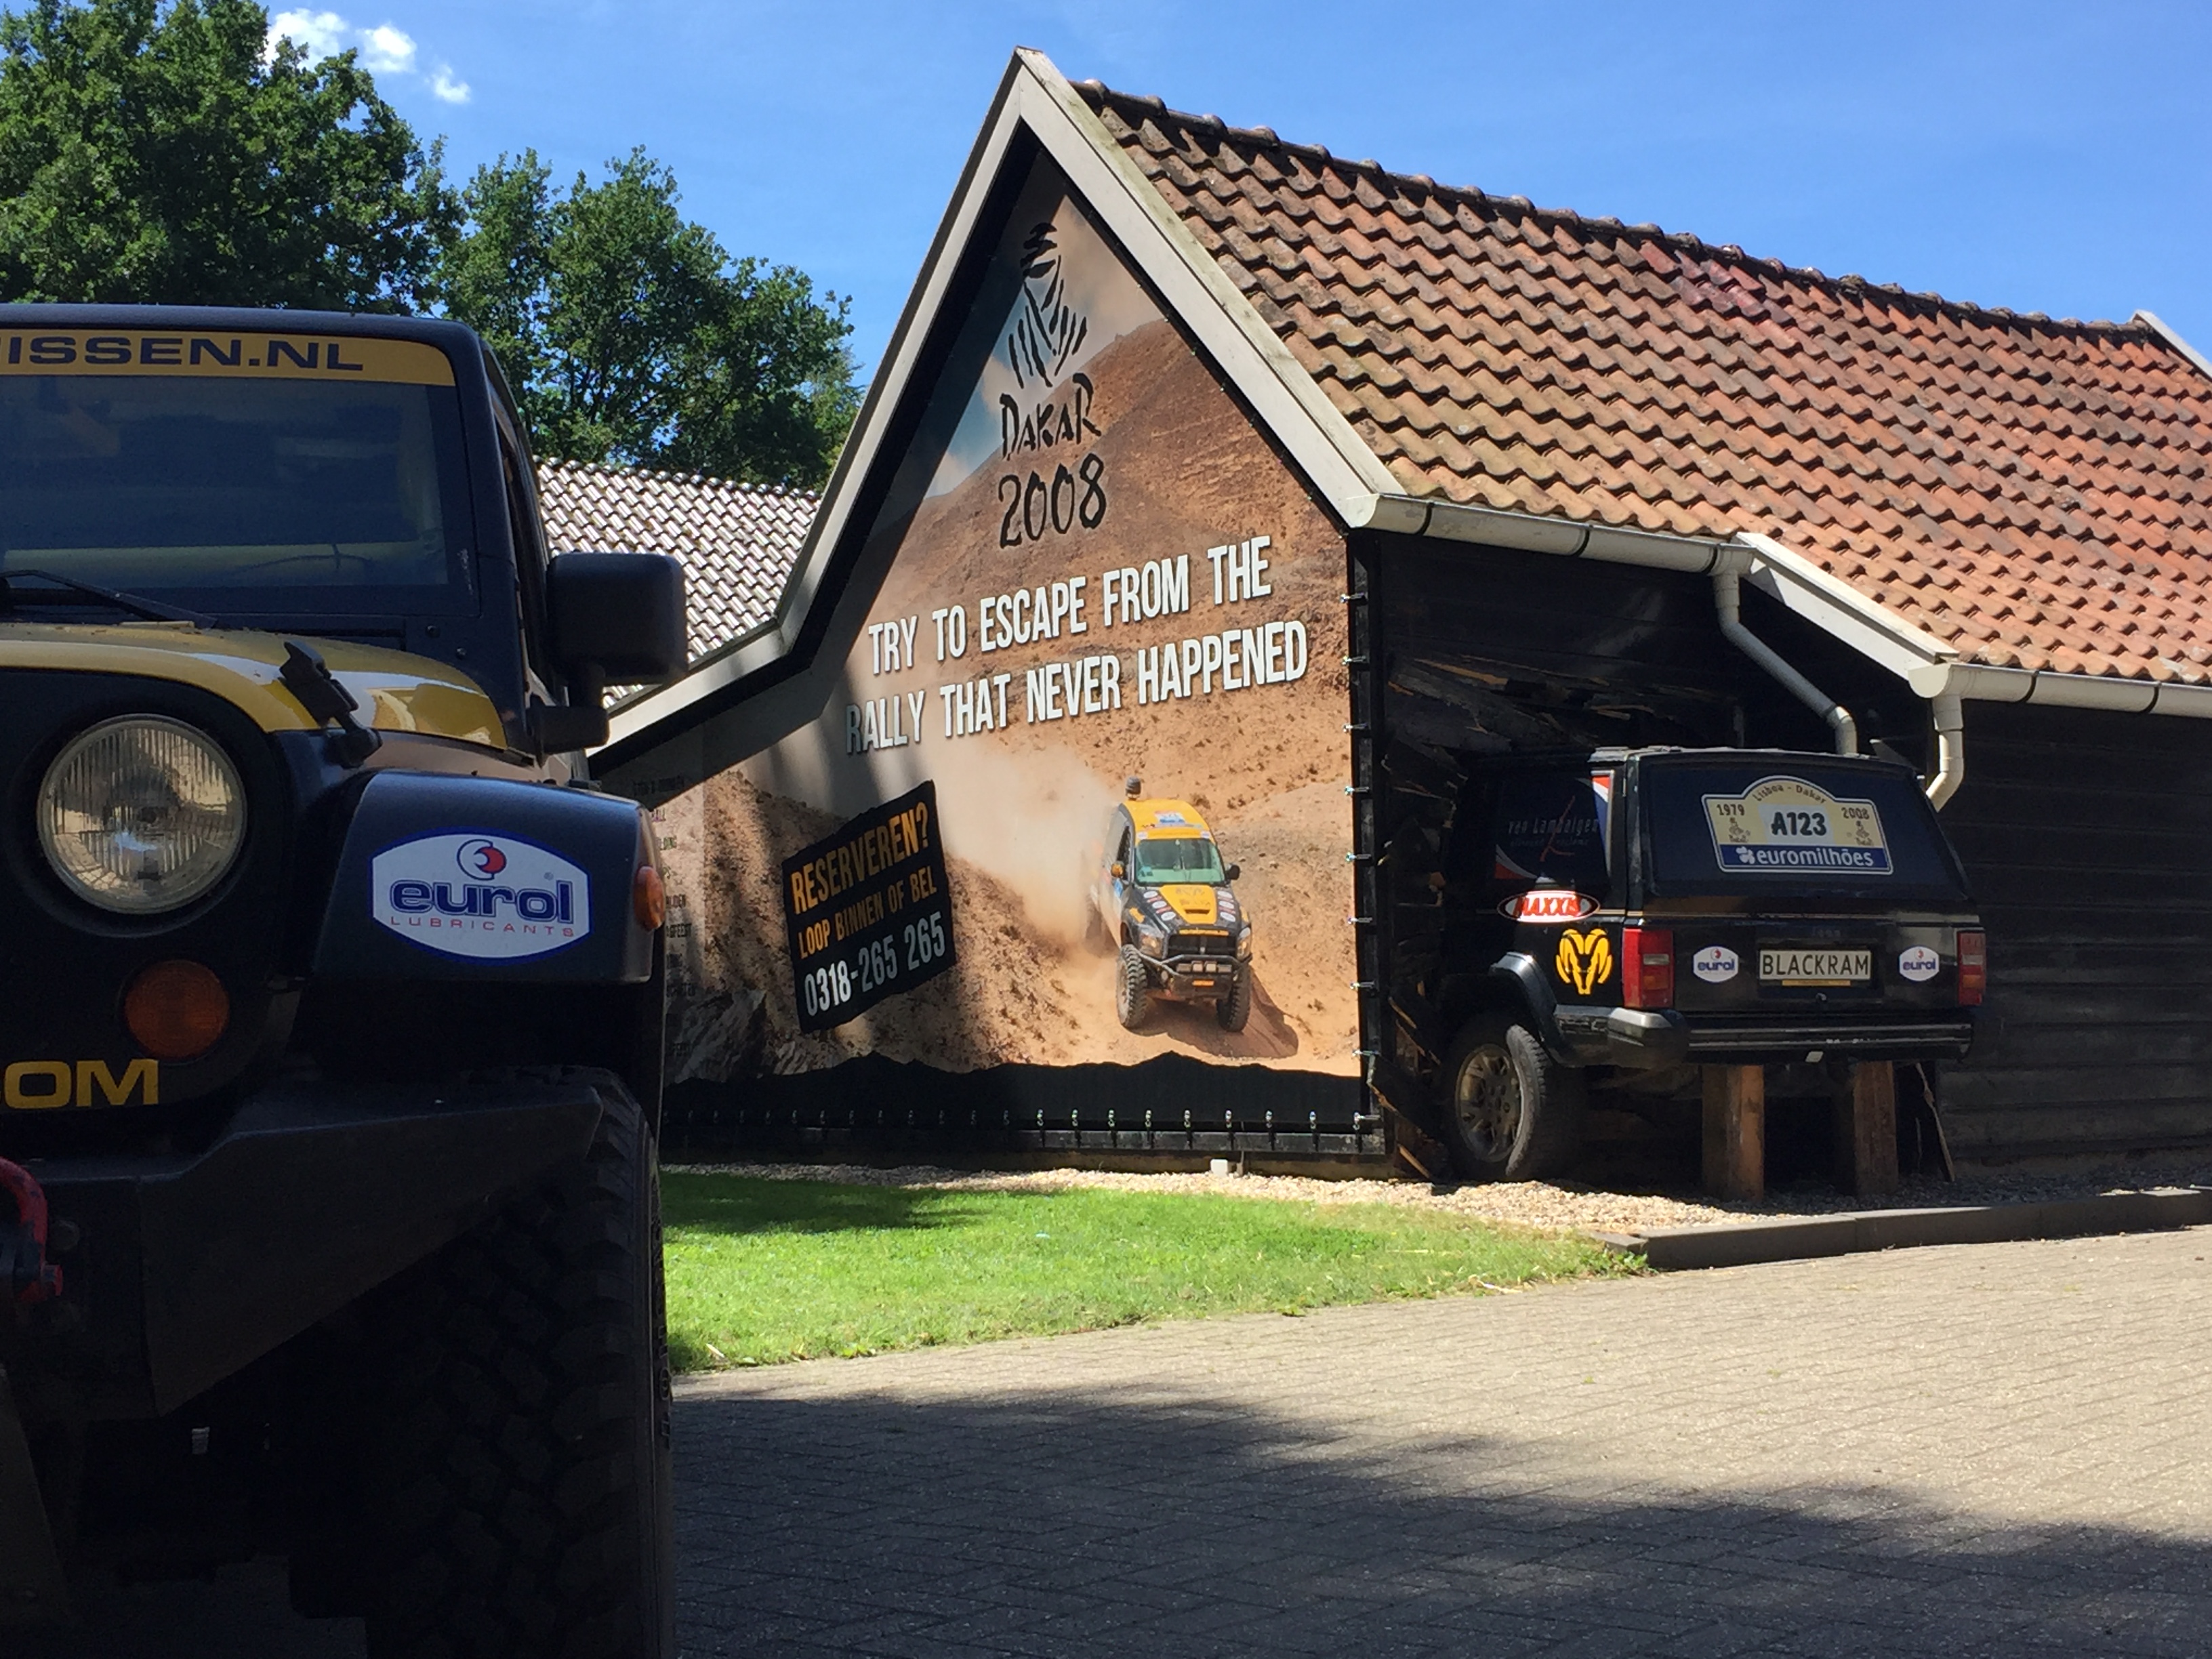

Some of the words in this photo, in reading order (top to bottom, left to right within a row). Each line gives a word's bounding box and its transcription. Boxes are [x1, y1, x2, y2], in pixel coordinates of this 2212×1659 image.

[0, 336, 364, 371] ISSEN.NL
[1000, 372, 1102, 462] DAKAR
[998, 452, 1107, 550] 2008
[869, 616, 918, 676] TRY
[933, 605, 966, 661] TO
[980, 576, 1088, 653] ESCAPE
[1103, 554, 1190, 627] FROM
[1208, 535, 1272, 605] THE
[845, 690, 926, 754] RALLY
[940, 673, 1012, 737] THAT
[1027, 655, 1122, 724] NEVER
[1137, 619, 1308, 705] HAPPENED
[1717, 804, 1746, 816] 1979
[1753, 784, 1784, 801] Lisboa
[1796, 784, 1827, 804] Dakar
[1770, 811, 1828, 836] A123
[1841, 806, 1870, 820] 2008
[791, 802, 929, 915] RESERVEREN?
[1757, 847, 1875, 867] euromilhões
[390, 879, 575, 924] eurol
[798, 918, 831, 960] LOOP
[836, 890, 884, 941] BINNEN
[888, 880, 905, 913] OF
[909, 865, 938, 903] BEL
[390, 915, 575, 937] LUBRICANTS
[804, 933, 899, 1017] 0318-265
[904, 910, 947, 971] 265
[1697, 958, 1735, 971] eurol
[1762, 953, 1870, 976] BLACKRAM
[1902, 958, 1936, 971] eurol
[0, 1058, 160, 1110] OM
